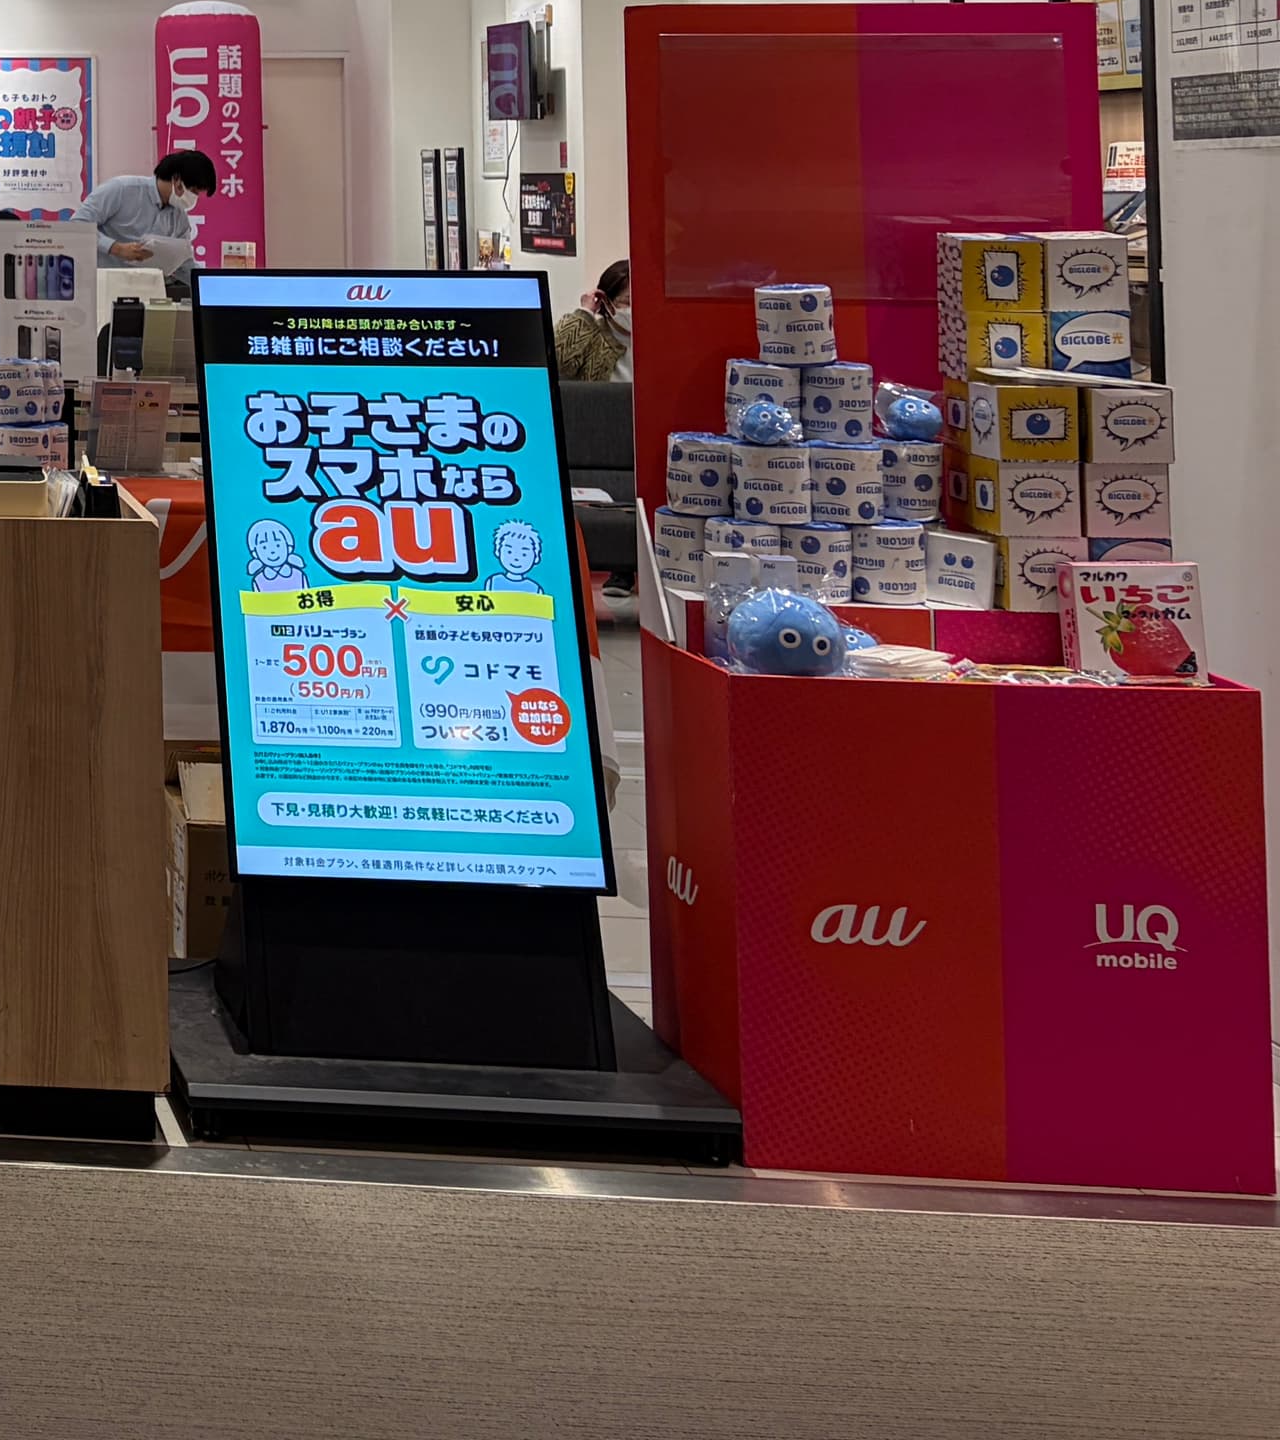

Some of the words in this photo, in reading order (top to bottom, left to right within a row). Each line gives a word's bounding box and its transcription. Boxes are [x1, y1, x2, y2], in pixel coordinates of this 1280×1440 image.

[166, 46, 210, 129] UQ
[216, 44, 245, 199] 話題のスマホ
[346, 283, 391, 301] au
[247, 335, 500, 359] 混雑前にご相談ください!
[246, 392, 520, 448] お子さまの
[264, 446, 516, 499] スマホなら
[814, 460, 856, 471] BIGLOBE
[743, 481, 784, 492] BIGLOBE
[318, 504, 461, 565] au
[938, 576, 976, 591] BIGLOBE
[1079, 571, 1128, 582] マルカワ
[296, 592, 335, 609] お得
[455, 594, 495, 612] 安心
[1079, 585, 1194, 605] いちご
[415, 630, 544, 643] 話題の子ども見守りアプリ
[463, 663, 543, 681] コドマモ
[421, 725, 509, 742] ついてくる!
[402, 806, 561, 826] お気軽にご来店ください
[667, 855, 699, 905] au
[809, 903, 927, 947] au
[1094, 903, 1180, 952] UQ
[1095, 953, 1179, 970] mobile
